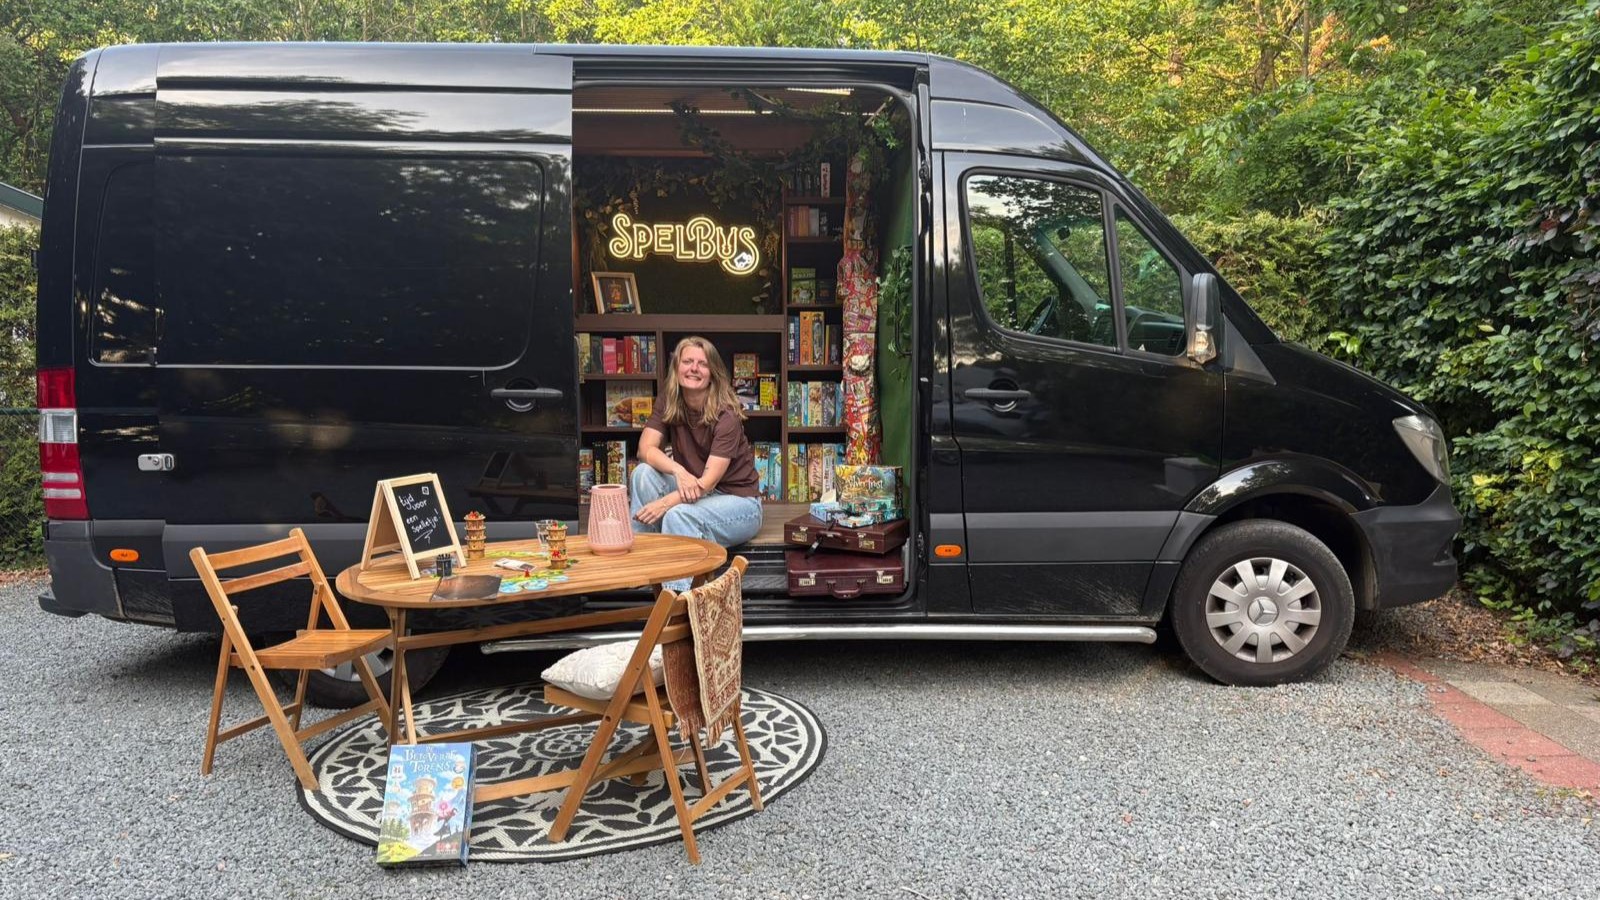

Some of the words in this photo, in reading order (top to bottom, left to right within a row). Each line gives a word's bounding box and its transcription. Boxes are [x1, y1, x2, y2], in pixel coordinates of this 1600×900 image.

[398, 493, 414, 510] tijd
[412, 499, 427, 511] voor
[406, 515, 418, 524] een
